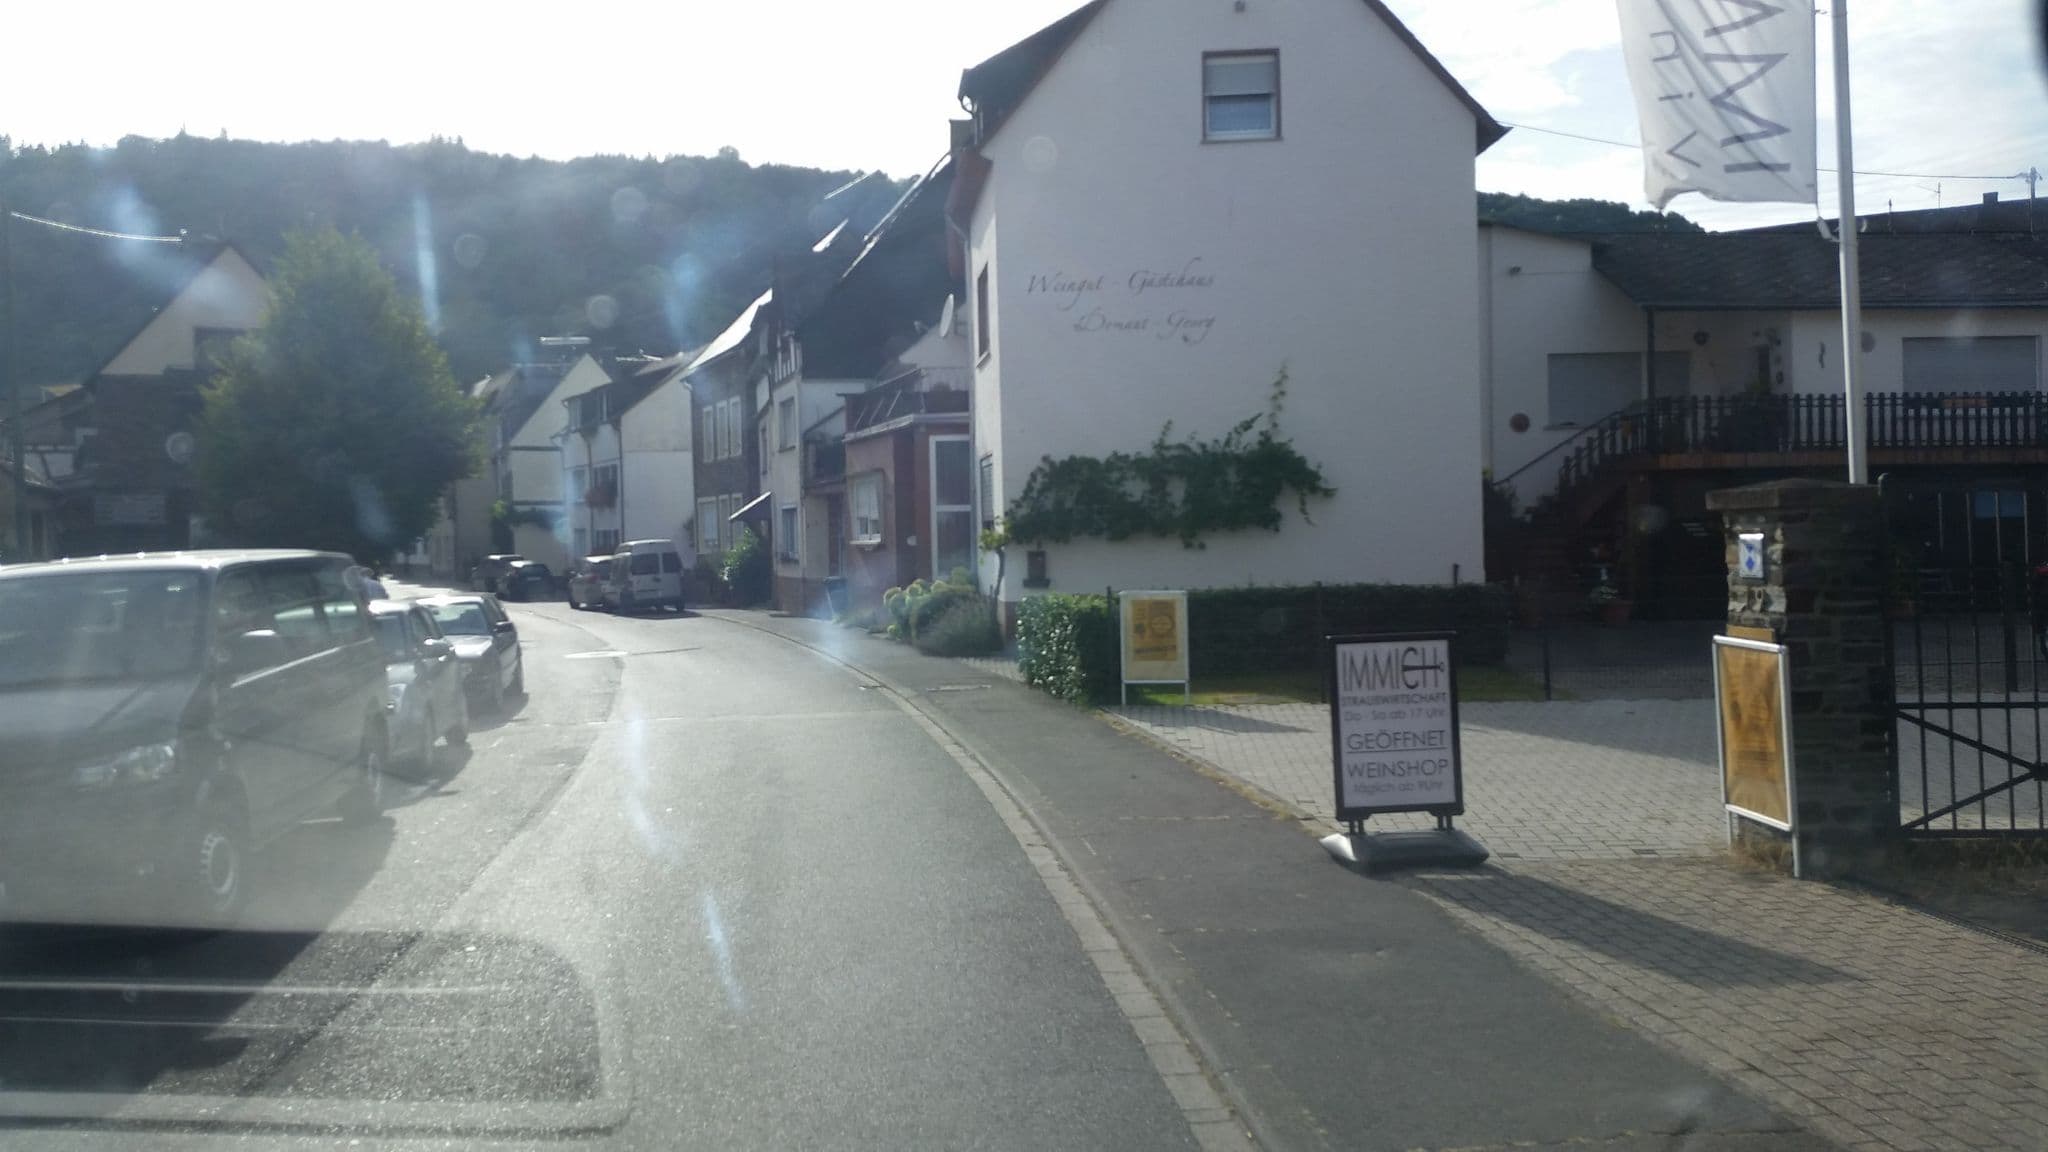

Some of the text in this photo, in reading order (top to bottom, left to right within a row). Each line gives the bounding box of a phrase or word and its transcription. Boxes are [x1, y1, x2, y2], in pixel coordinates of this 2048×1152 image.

[1343, 645, 1444, 692] IMMICH
[1347, 728, 1446, 750] GEÖFFNET
[1346, 758, 1449, 778] WEINSHOP
